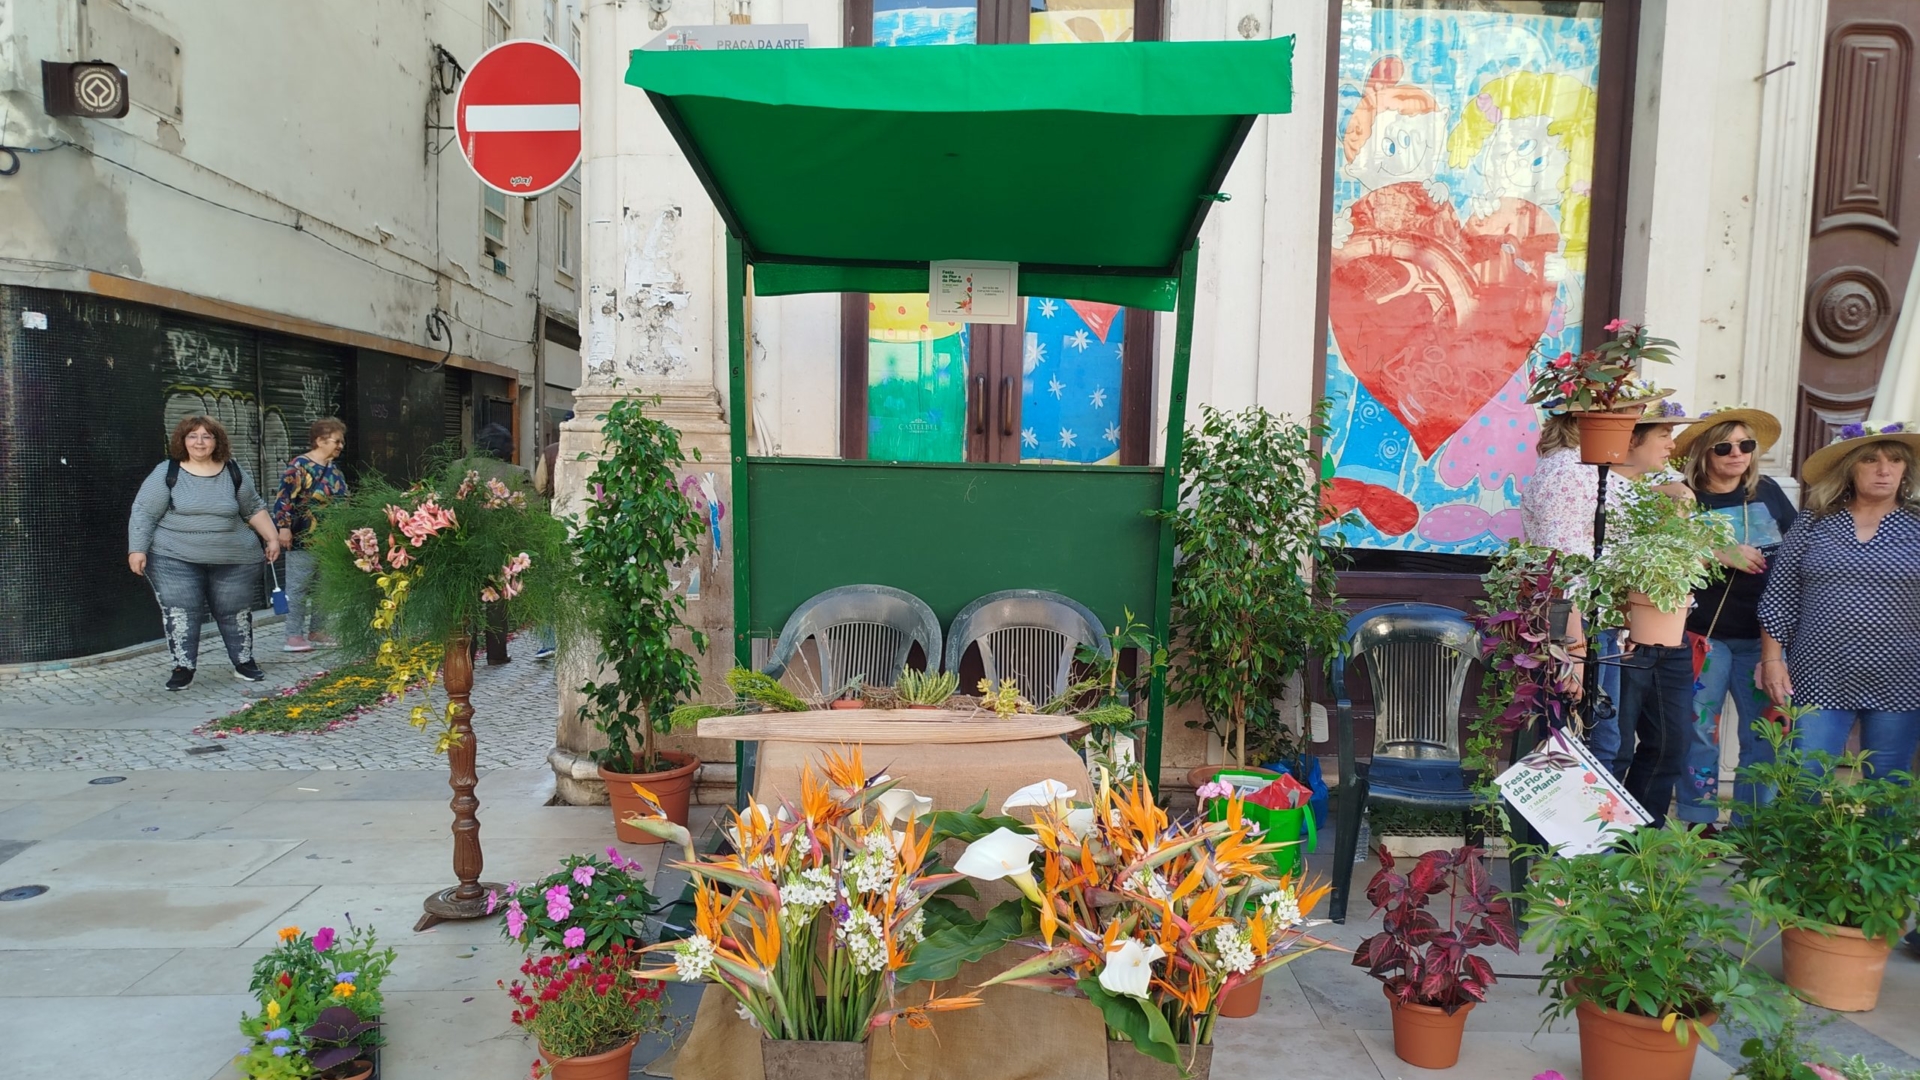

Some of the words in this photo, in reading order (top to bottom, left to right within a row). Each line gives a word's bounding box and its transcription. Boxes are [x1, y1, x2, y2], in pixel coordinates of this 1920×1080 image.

[757, 39, 773, 50] DA
[776, 39, 805, 49] ARTE
[1504, 769, 1530, 790] Festa
[1512, 786, 1525, 797] da
[1524, 772, 1543, 787] Flor
[1544, 766, 1552, 774] e
[1520, 793, 1533, 804] da
[1531, 772, 1562, 795] Planta
[1533, 794, 1548, 807] MAIO
